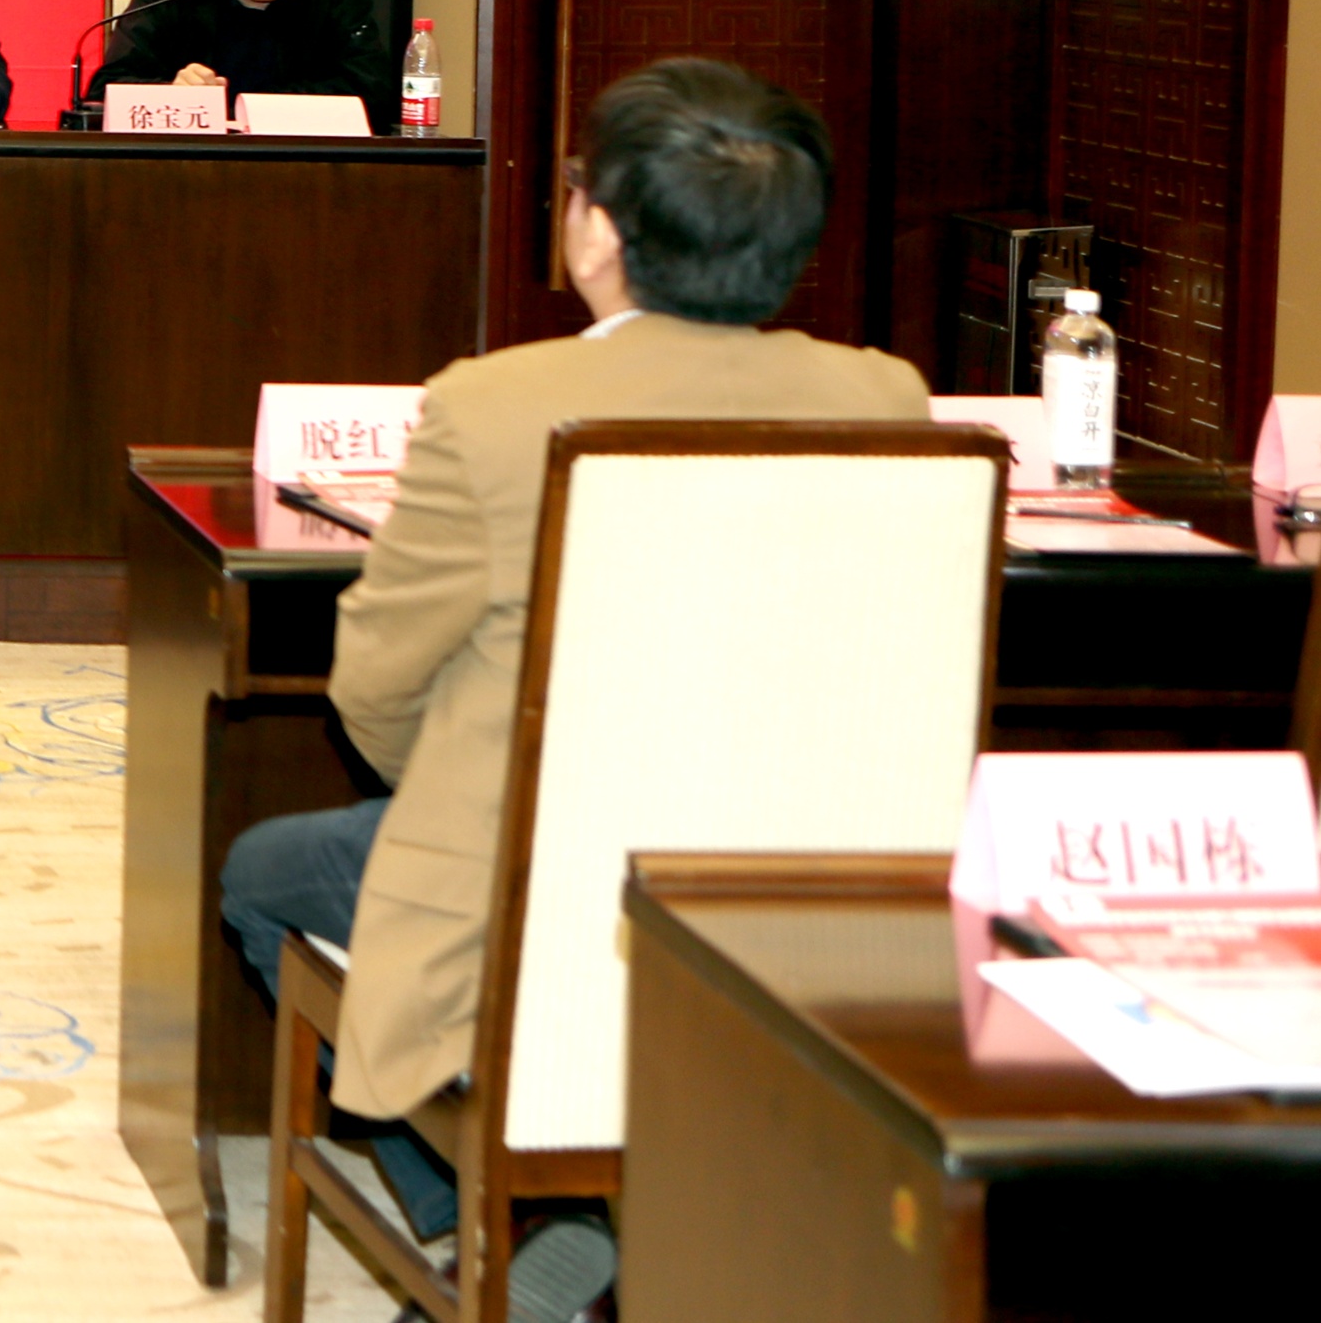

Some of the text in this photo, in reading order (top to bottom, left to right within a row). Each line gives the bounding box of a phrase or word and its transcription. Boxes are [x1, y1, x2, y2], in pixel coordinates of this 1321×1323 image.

[129, 104, 211, 130] 徐宝元
[301, 419, 412, 460] 脱红
